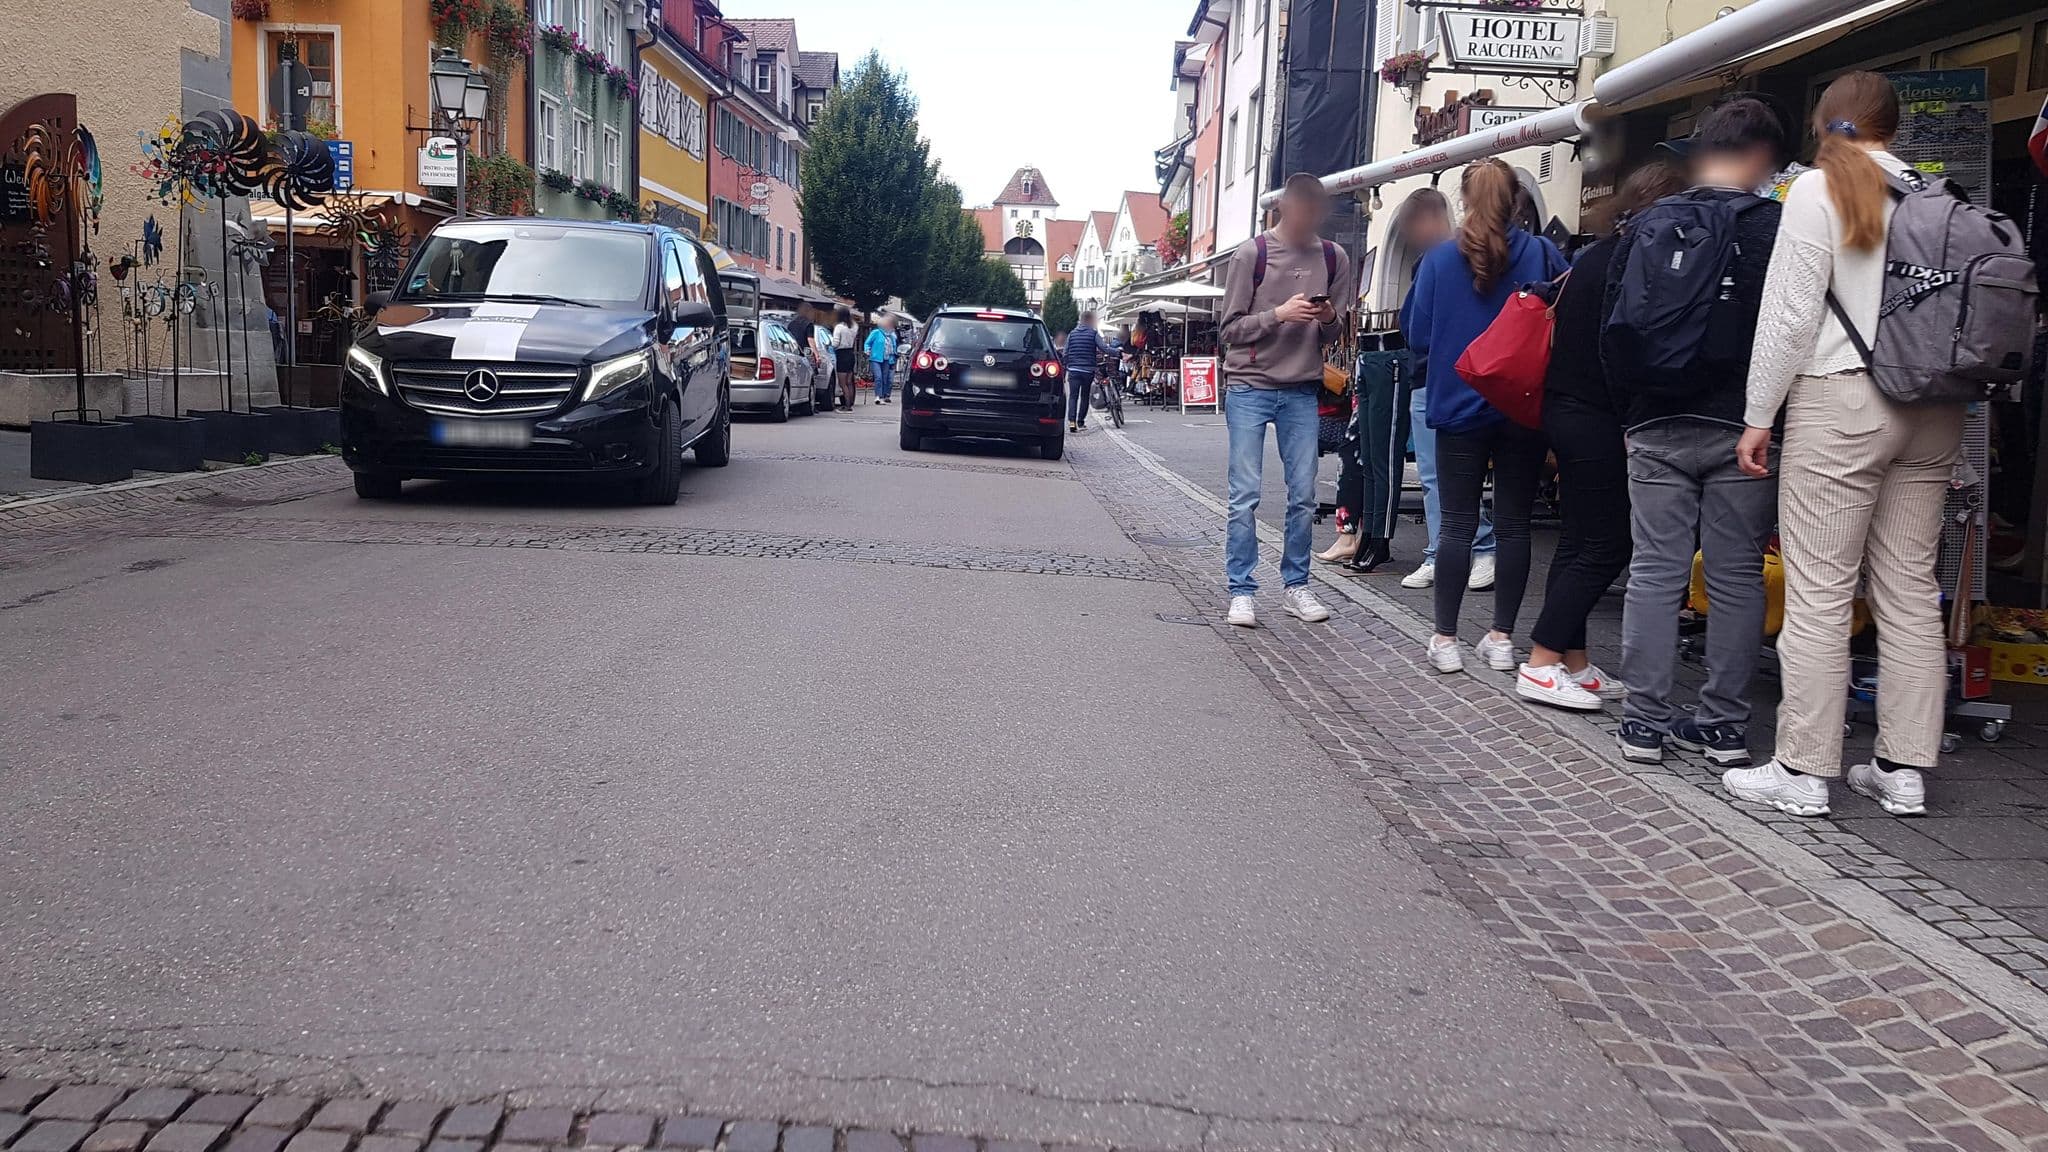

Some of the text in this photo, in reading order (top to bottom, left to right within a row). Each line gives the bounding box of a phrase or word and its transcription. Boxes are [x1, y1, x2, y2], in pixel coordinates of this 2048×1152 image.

[1470, 17, 1565, 42] HOTEL
[1467, 41, 1563, 60] RAUCHFANG
[1519, 122, 1543, 143] Mode
